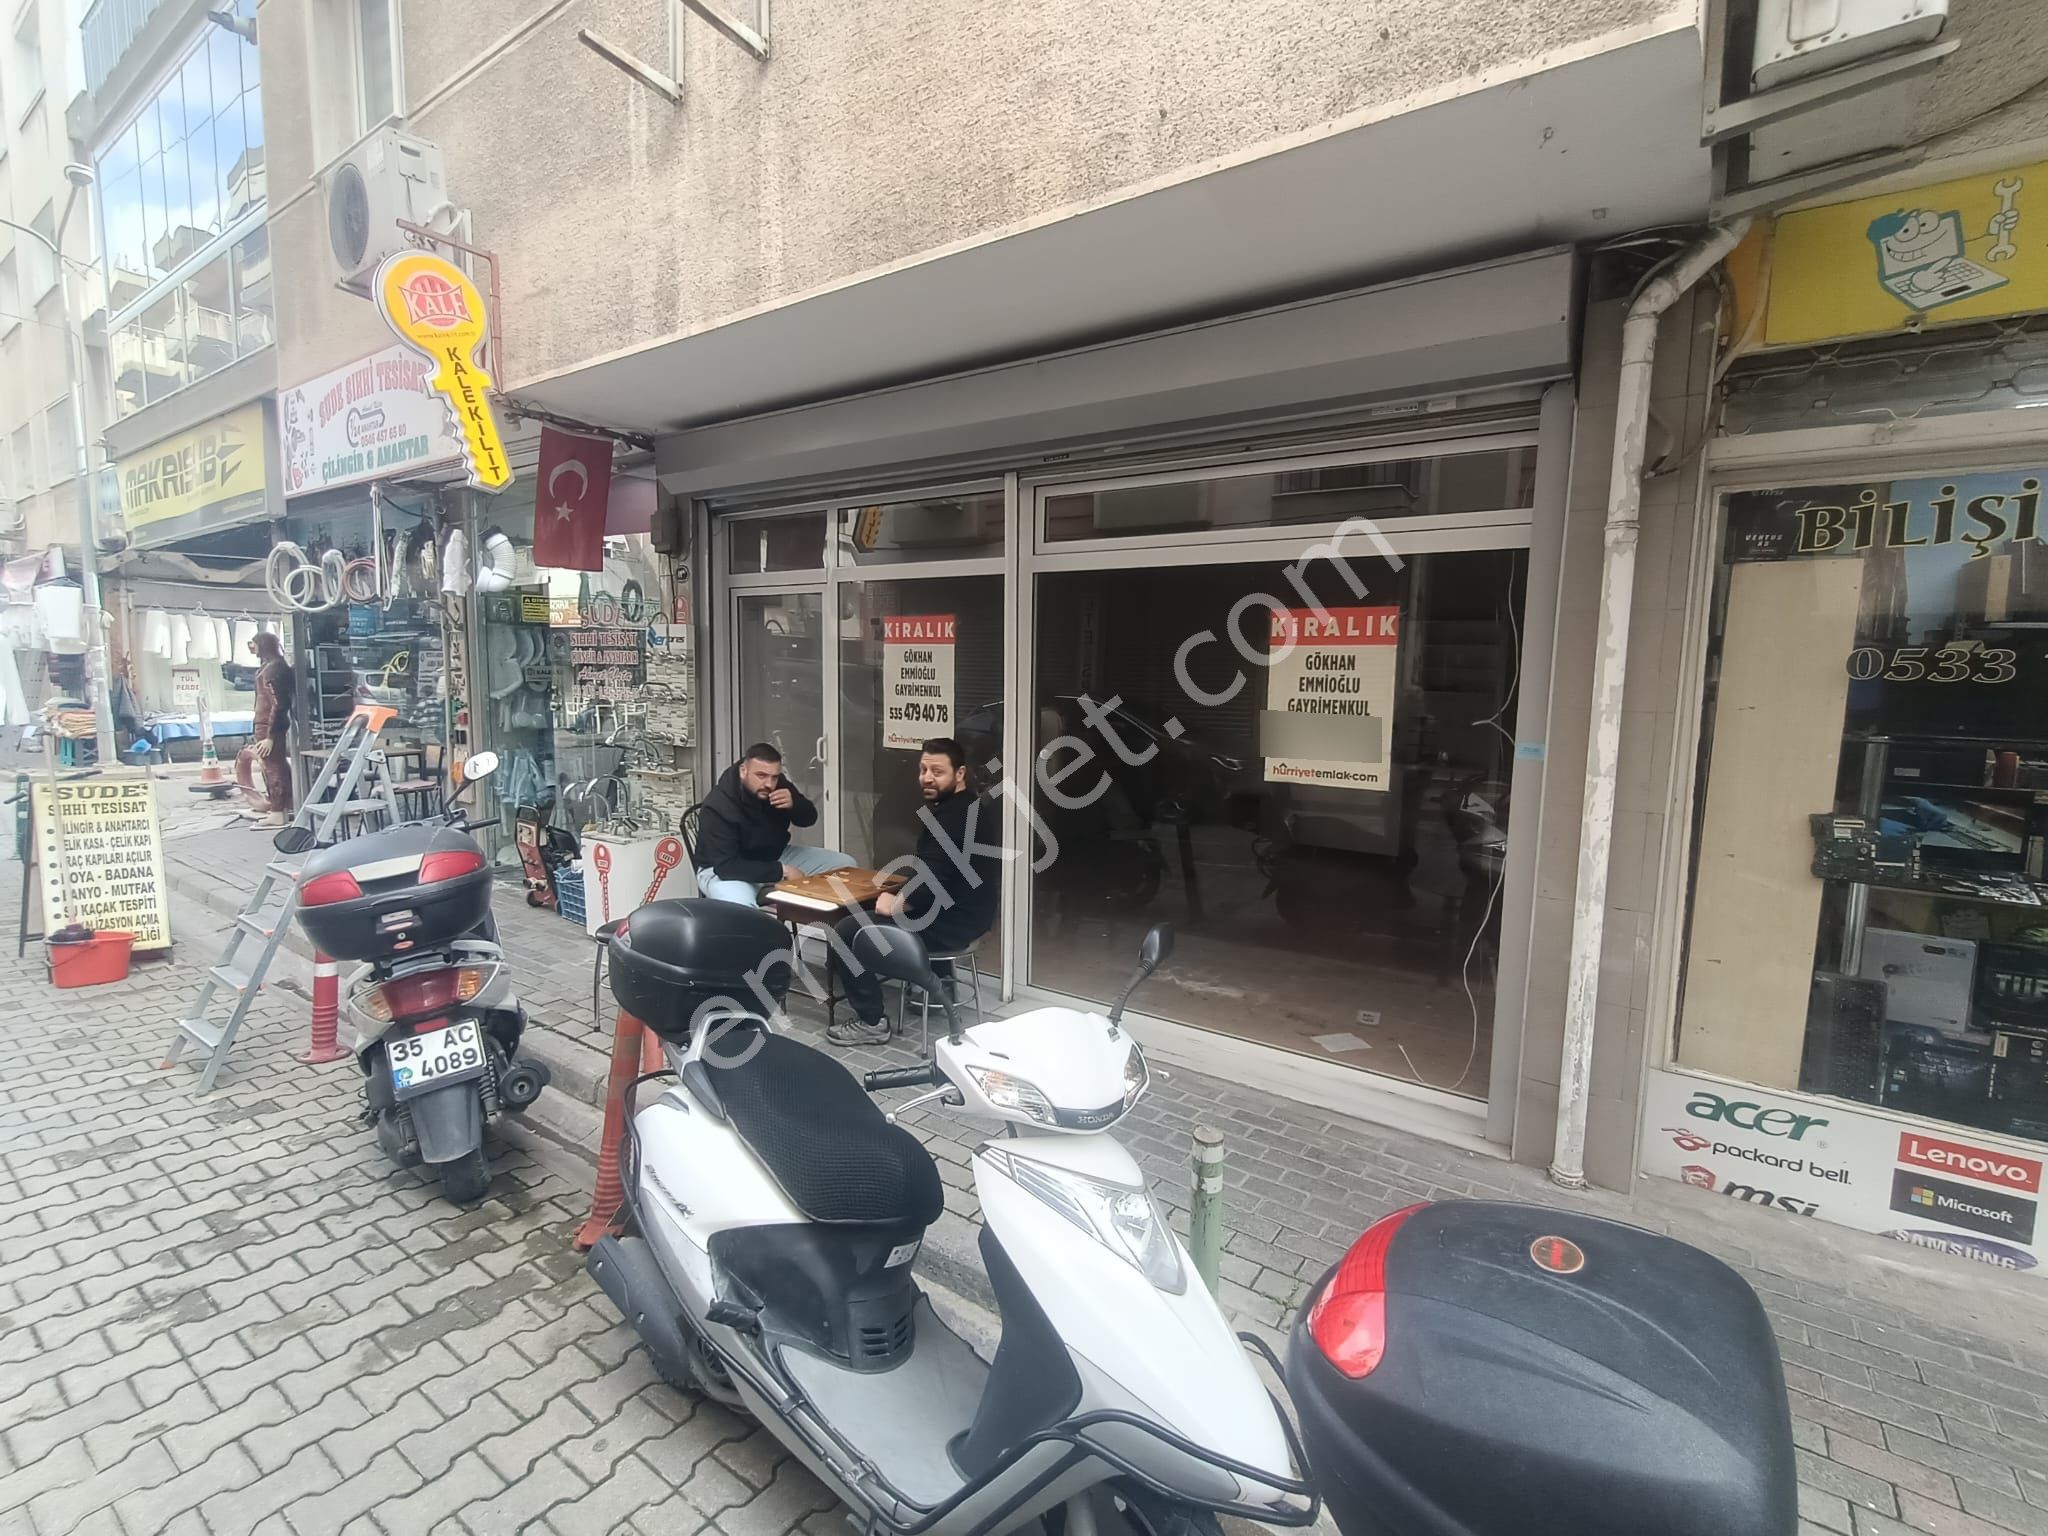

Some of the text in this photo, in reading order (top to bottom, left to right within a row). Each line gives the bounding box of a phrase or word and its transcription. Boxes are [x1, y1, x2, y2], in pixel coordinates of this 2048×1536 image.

[399, 285, 474, 325] KALE
[319, 379, 345, 429] SUDE
[322, 449, 365, 484] ÇİLİNGİR
[377, 435, 430, 468] ANAHTAR
[581, 602, 627, 629] SUDE
[904, 649, 933, 663] GÖKHAN
[1306, 652, 1356, 671] GÖKHAN
[1846, 647, 2017, 684] 0533
[900, 665, 936, 681] EMMİOĞLU
[895, 682, 942, 698] GAYRİMENKUL
[1299, 674, 1361, 694] EMMİOĞLU
[889, 702, 949, 723] 535 479 40 78
[1288, 696, 1370, 717] GAYRİMENKUL
[56, 785, 140, 800] SUDE
[92, 799, 147, 815] TESİSAT
[62, 819, 150, 835] İLİNGİR & ANAHTARCI
[64, 837, 82, 852] ELİK
[84, 836, 105, 850] KASA
[110, 835, 134, 852] ÇELİK
[134, 834, 151, 847] KAPI
[60, 850, 152, 870] RAÇ KAPILARI AÇILIR
[105, 866, 154, 881] BADANA
[111, 882, 156, 897] MUTFAK
[81, 901, 117, 918] KAÇAK
[120, 896, 157, 912] TESPİTİ
[136, 913, 160, 929] AÇMA
[393, 1025, 475, 1062] 35 AC
[421, 1047, 478, 1078] 4089
[1685, 1091, 1830, 1142] acer
[1712, 1142, 1803, 1173] packard
[1908, 1140, 2028, 1182] Lenovo
[1721, 1181, 1820, 1218] msi
[1937, 1194, 2014, 1224] Microsoft
